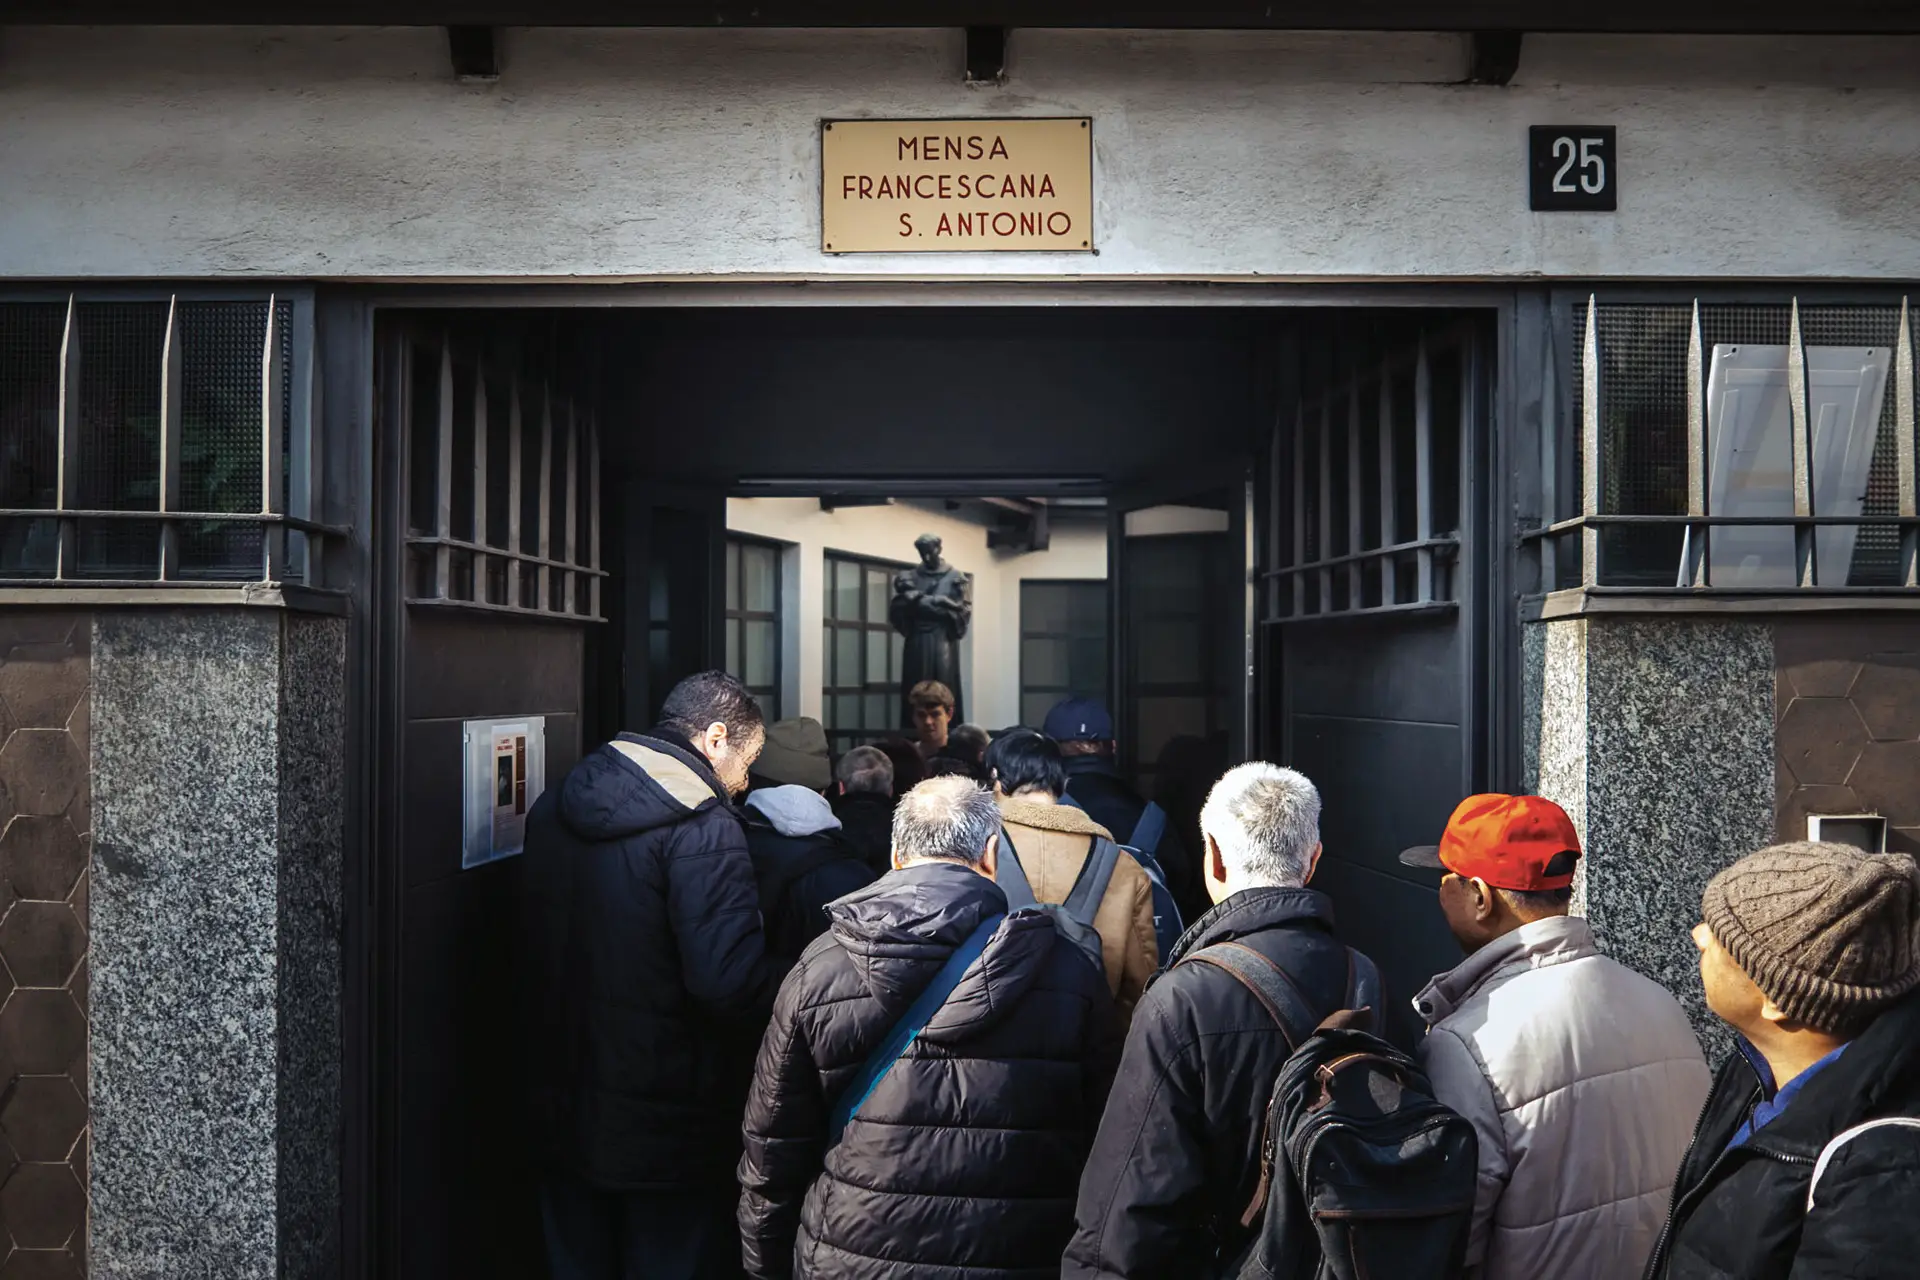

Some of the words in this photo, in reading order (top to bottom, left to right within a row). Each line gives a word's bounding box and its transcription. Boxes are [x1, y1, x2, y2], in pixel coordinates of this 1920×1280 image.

[898, 135, 1009, 161] MENSA
[1552, 136, 1605, 194] 25
[843, 173, 1056, 199] FRANCESCANA
[899, 212, 923, 237] S.
[936, 212, 1072, 237] ANTONIO
